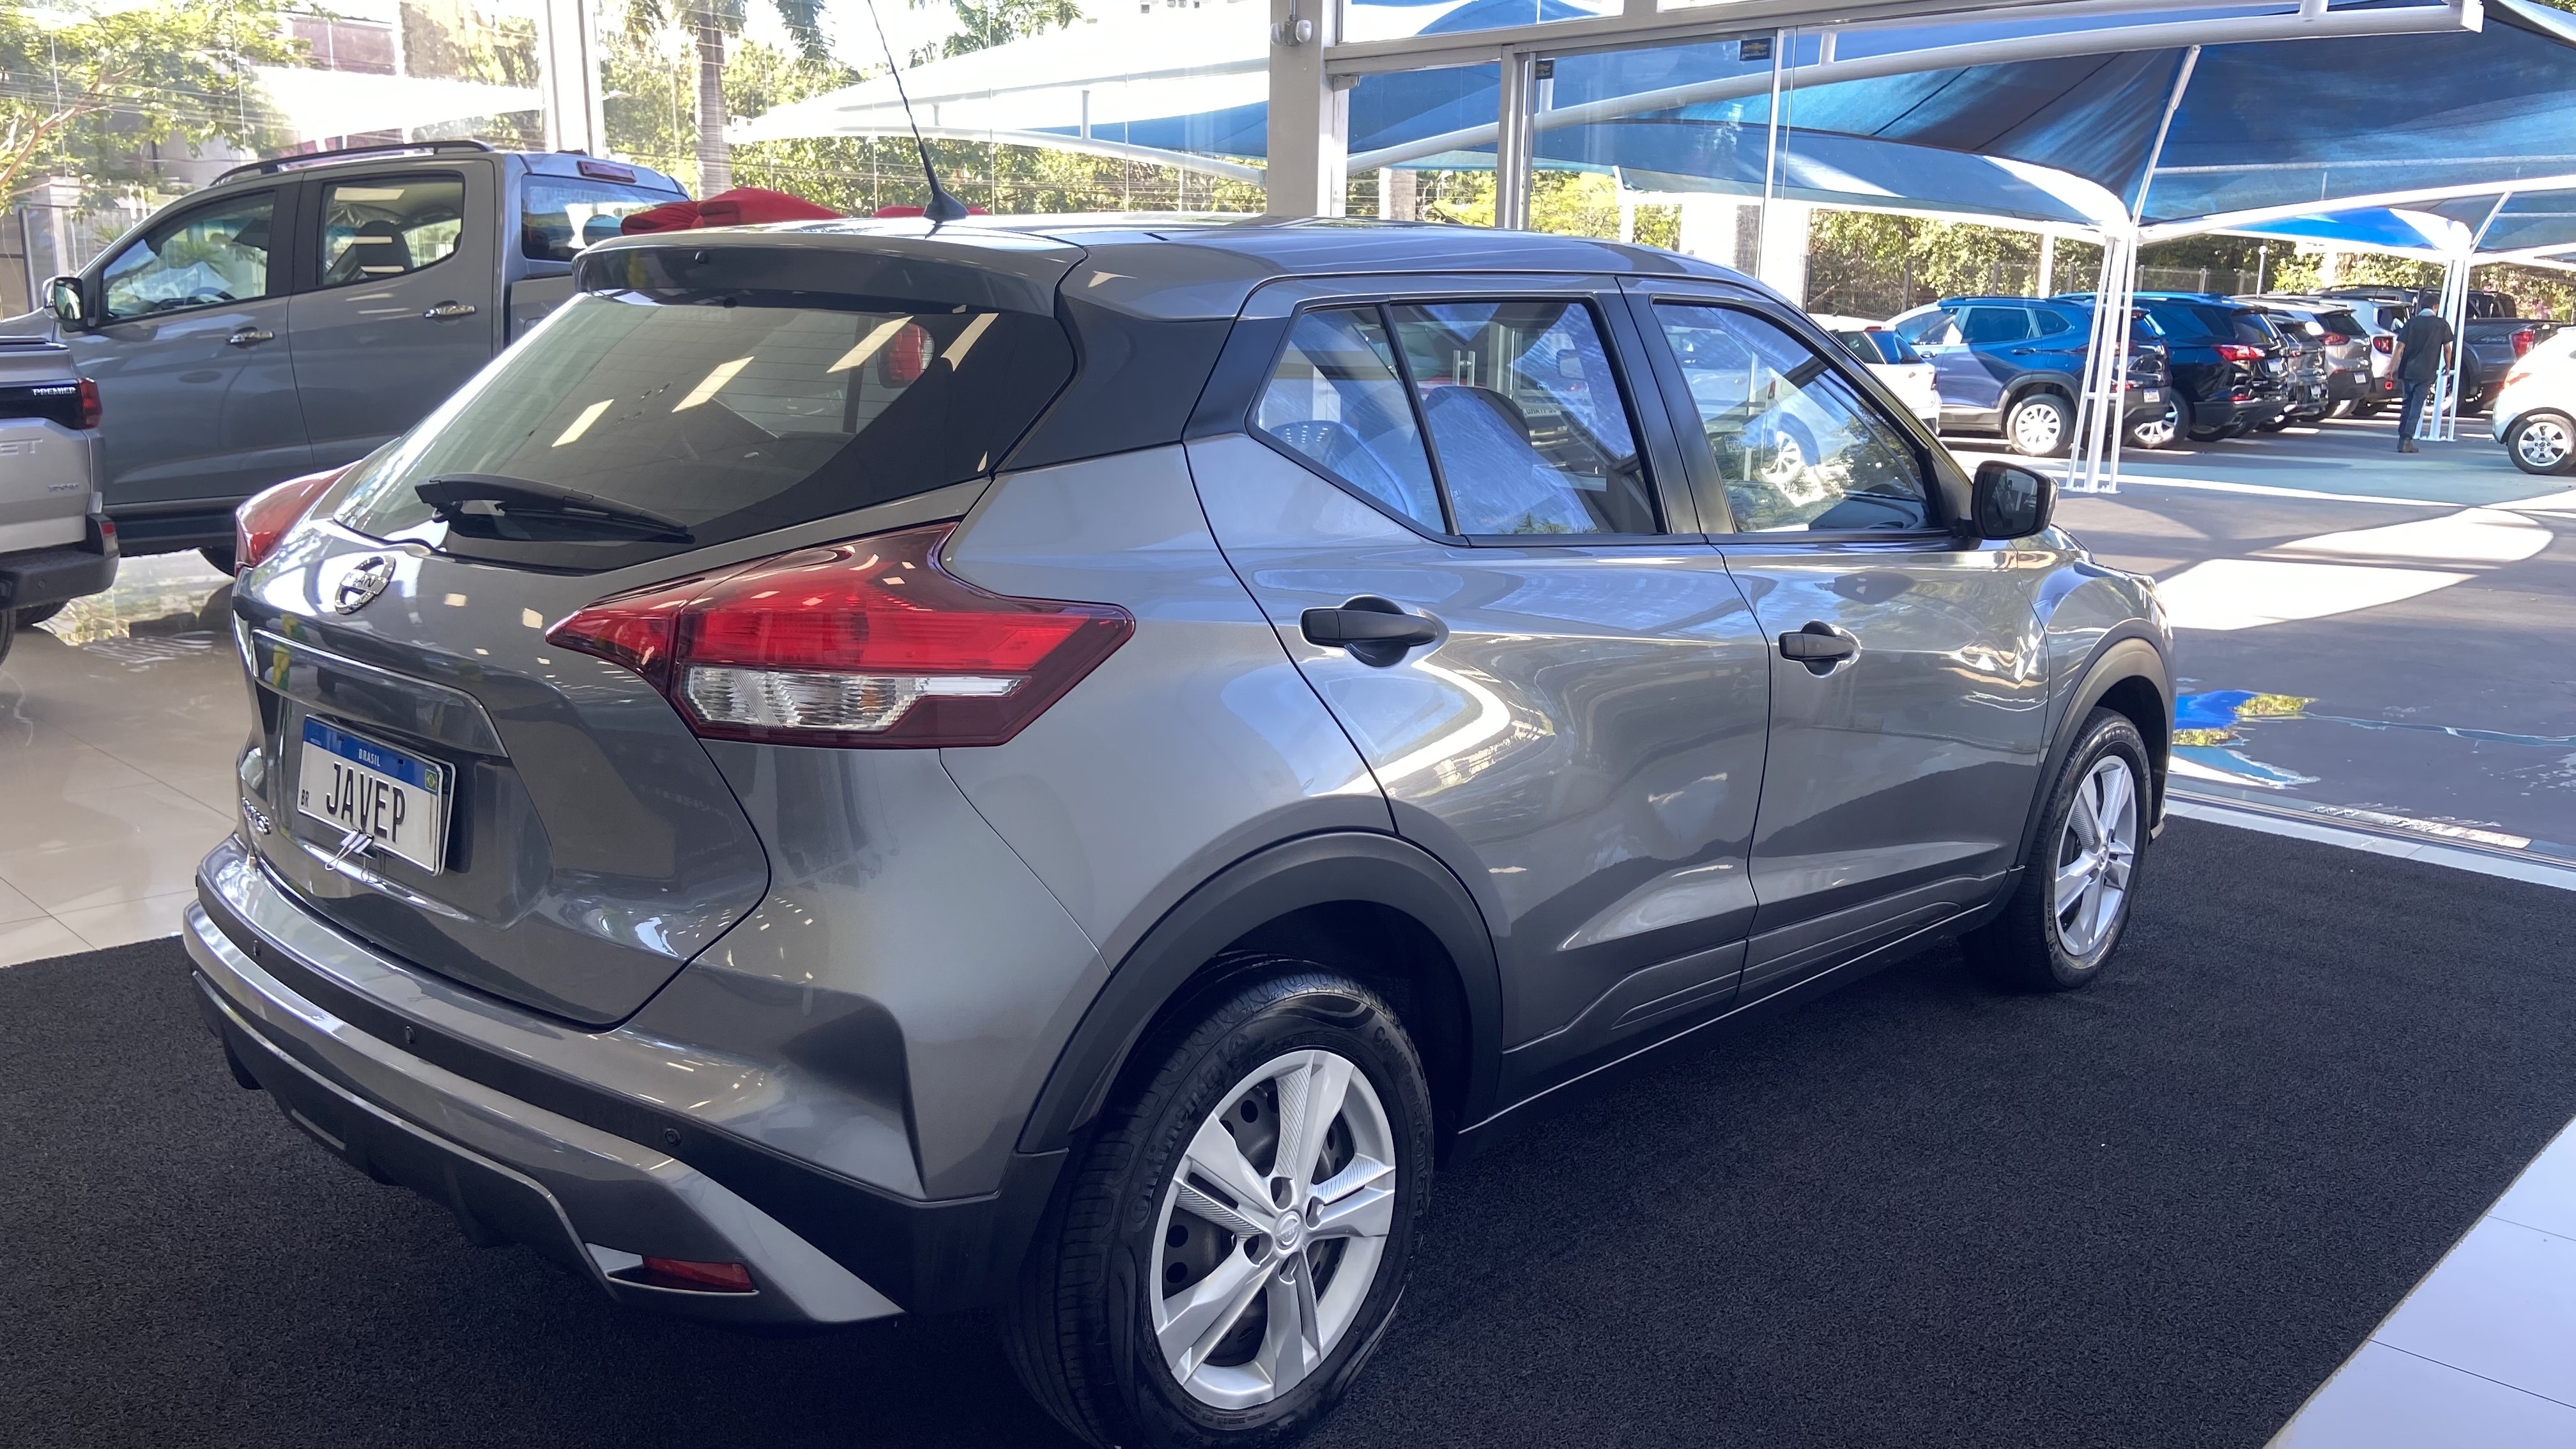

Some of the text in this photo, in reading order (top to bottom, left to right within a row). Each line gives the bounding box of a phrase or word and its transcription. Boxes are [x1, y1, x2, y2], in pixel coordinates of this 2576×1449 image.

[33, 387, 76, 395] PREMIER
[358, 748, 381, 767] BRASIL
[301, 789, 309, 808] BR
[326, 761, 406, 843] JAVEP
